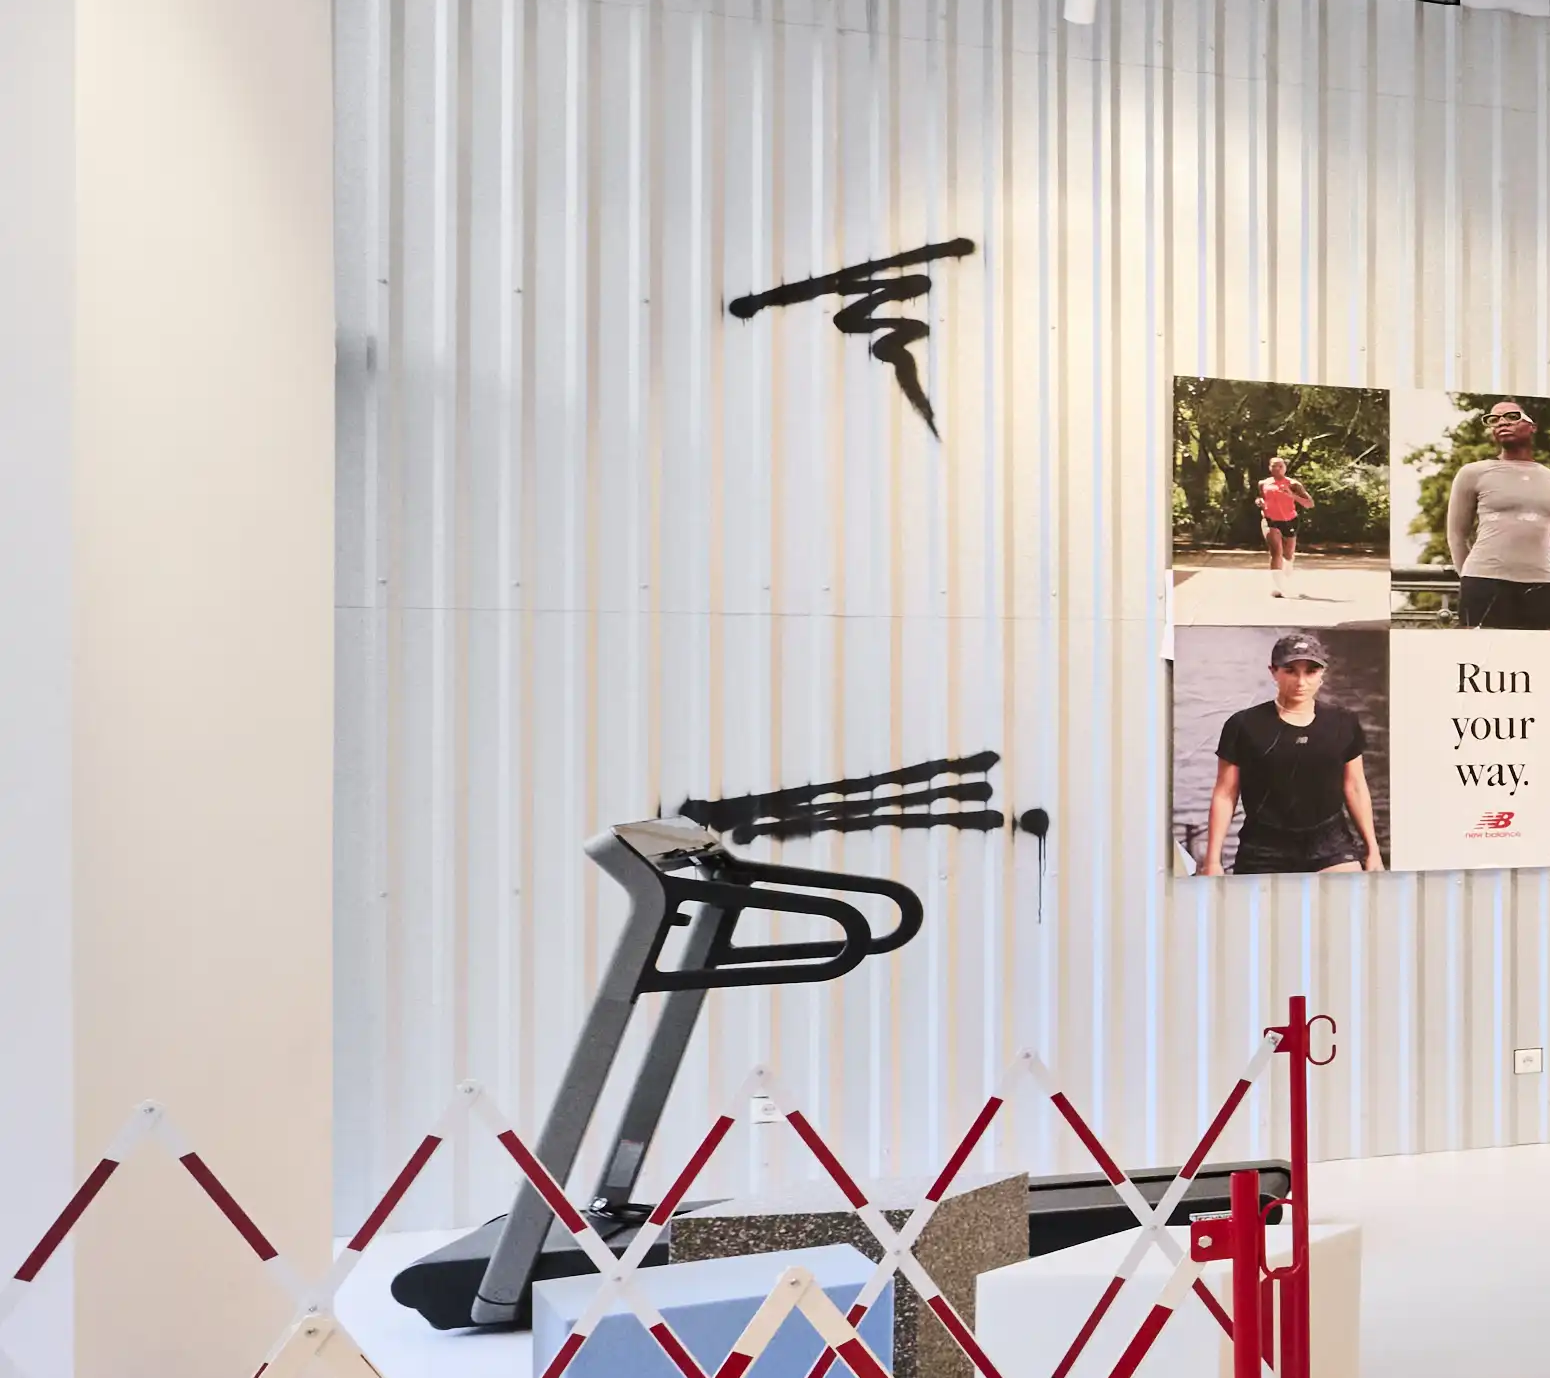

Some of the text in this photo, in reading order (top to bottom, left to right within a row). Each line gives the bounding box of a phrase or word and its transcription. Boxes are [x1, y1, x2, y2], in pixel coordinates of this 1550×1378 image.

[1457, 663, 1532, 693] Run
[1451, 717, 1535, 750] your
[1455, 763, 1528, 796] way.
